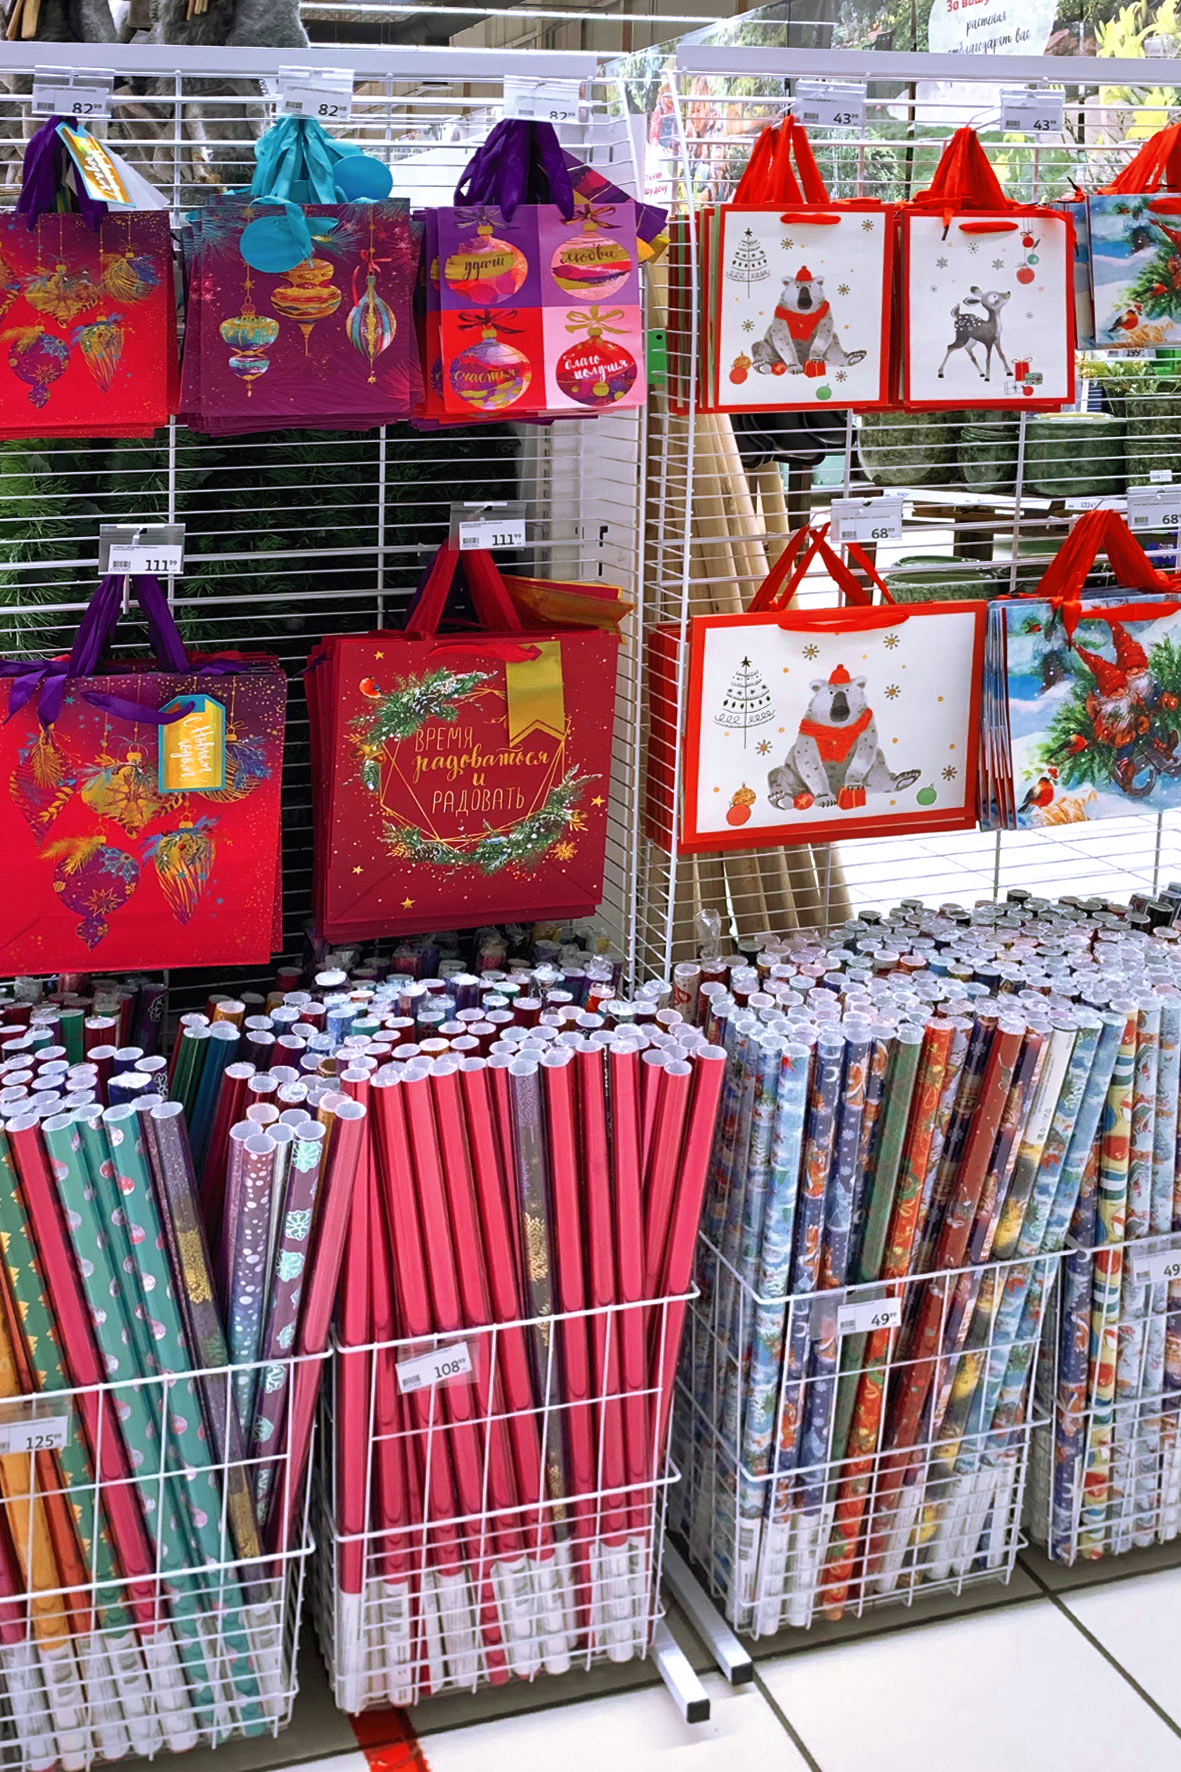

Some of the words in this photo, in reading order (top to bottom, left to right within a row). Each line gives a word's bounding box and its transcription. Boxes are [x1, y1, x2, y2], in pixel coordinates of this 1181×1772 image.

[414, 726, 474, 752] ВРЕМЯ
[412, 743, 549, 784] радоваться
[472, 772, 487, 786] и
[432, 786, 525, 817] РАДОВАТЬ
